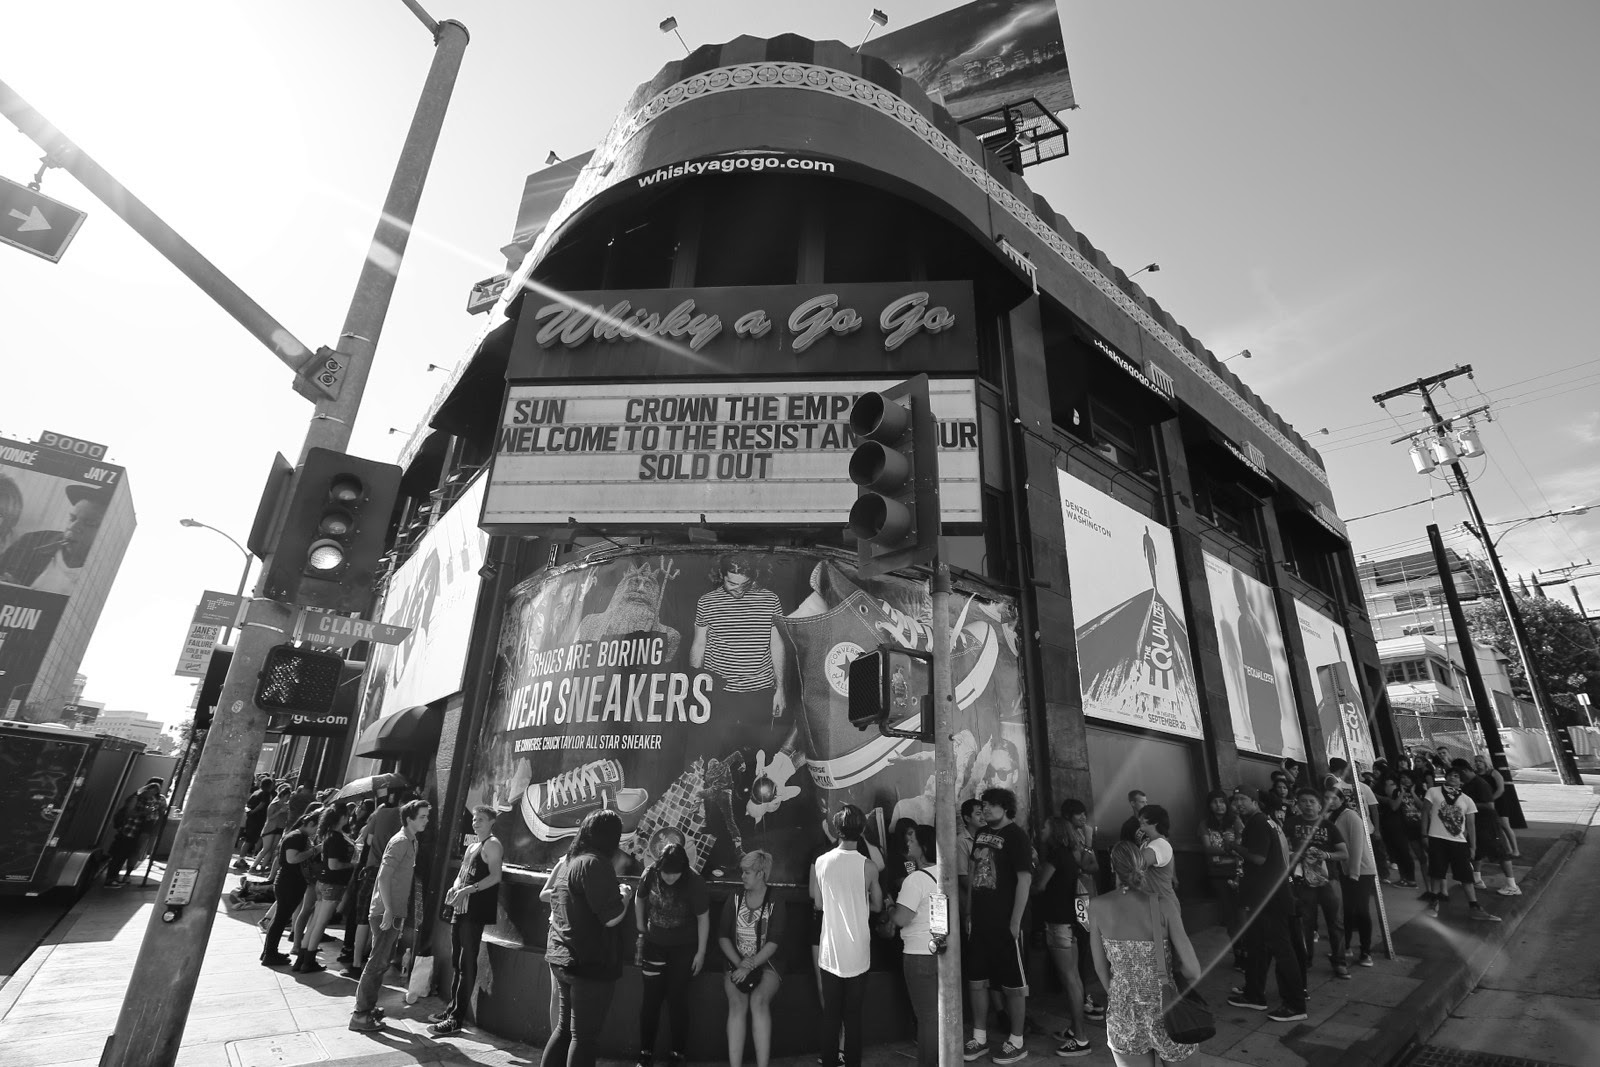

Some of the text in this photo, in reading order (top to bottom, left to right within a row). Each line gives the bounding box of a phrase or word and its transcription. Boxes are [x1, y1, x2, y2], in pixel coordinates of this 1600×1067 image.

[638, 157, 835, 187] whiskyagogo.com
[536, 291, 956, 353] Whisky a Go Go
[513, 395, 861, 424] SUN CROWN THE EMP
[43, 433, 104, 458] 9000
[501, 426, 619, 452] WELCOME
[625, 426, 660, 450] TO
[666, 425, 718, 450] THE
[722, 423, 859, 450] RESISTAN
[83, 467, 117, 484] JAY Z
[639, 452, 773, 480] SOLD OUT
[1065, 499, 1092, 519] DENZEL
[1066, 509, 1112, 538] WASHINGTON
[0, 604, 42, 630] RUN
[319, 616, 397, 639] CLARK ST
[192, 625, 218, 636] JANE'S
[307, 633, 335, 645] 1100 N
[188, 640, 213, 649] FAILURE
[1144, 600, 1178, 692] EQUALIZER
[1144, 645, 1152, 661] THE
[532, 638, 664, 678] SHOES ARE BORING
[1247, 666, 1275, 685] EQUALIZER
[506, 673, 713, 732] WEAR SNEAKERS
[1148, 714, 1187, 731] SEPTEMBER 26
[542, 736, 561, 750] CHUCK
[561, 735, 585, 750] TAYLOR
[585, 735, 598, 749] ALL
[599, 735, 620, 750] STAR
[621, 734, 662, 750] SNEAKER
